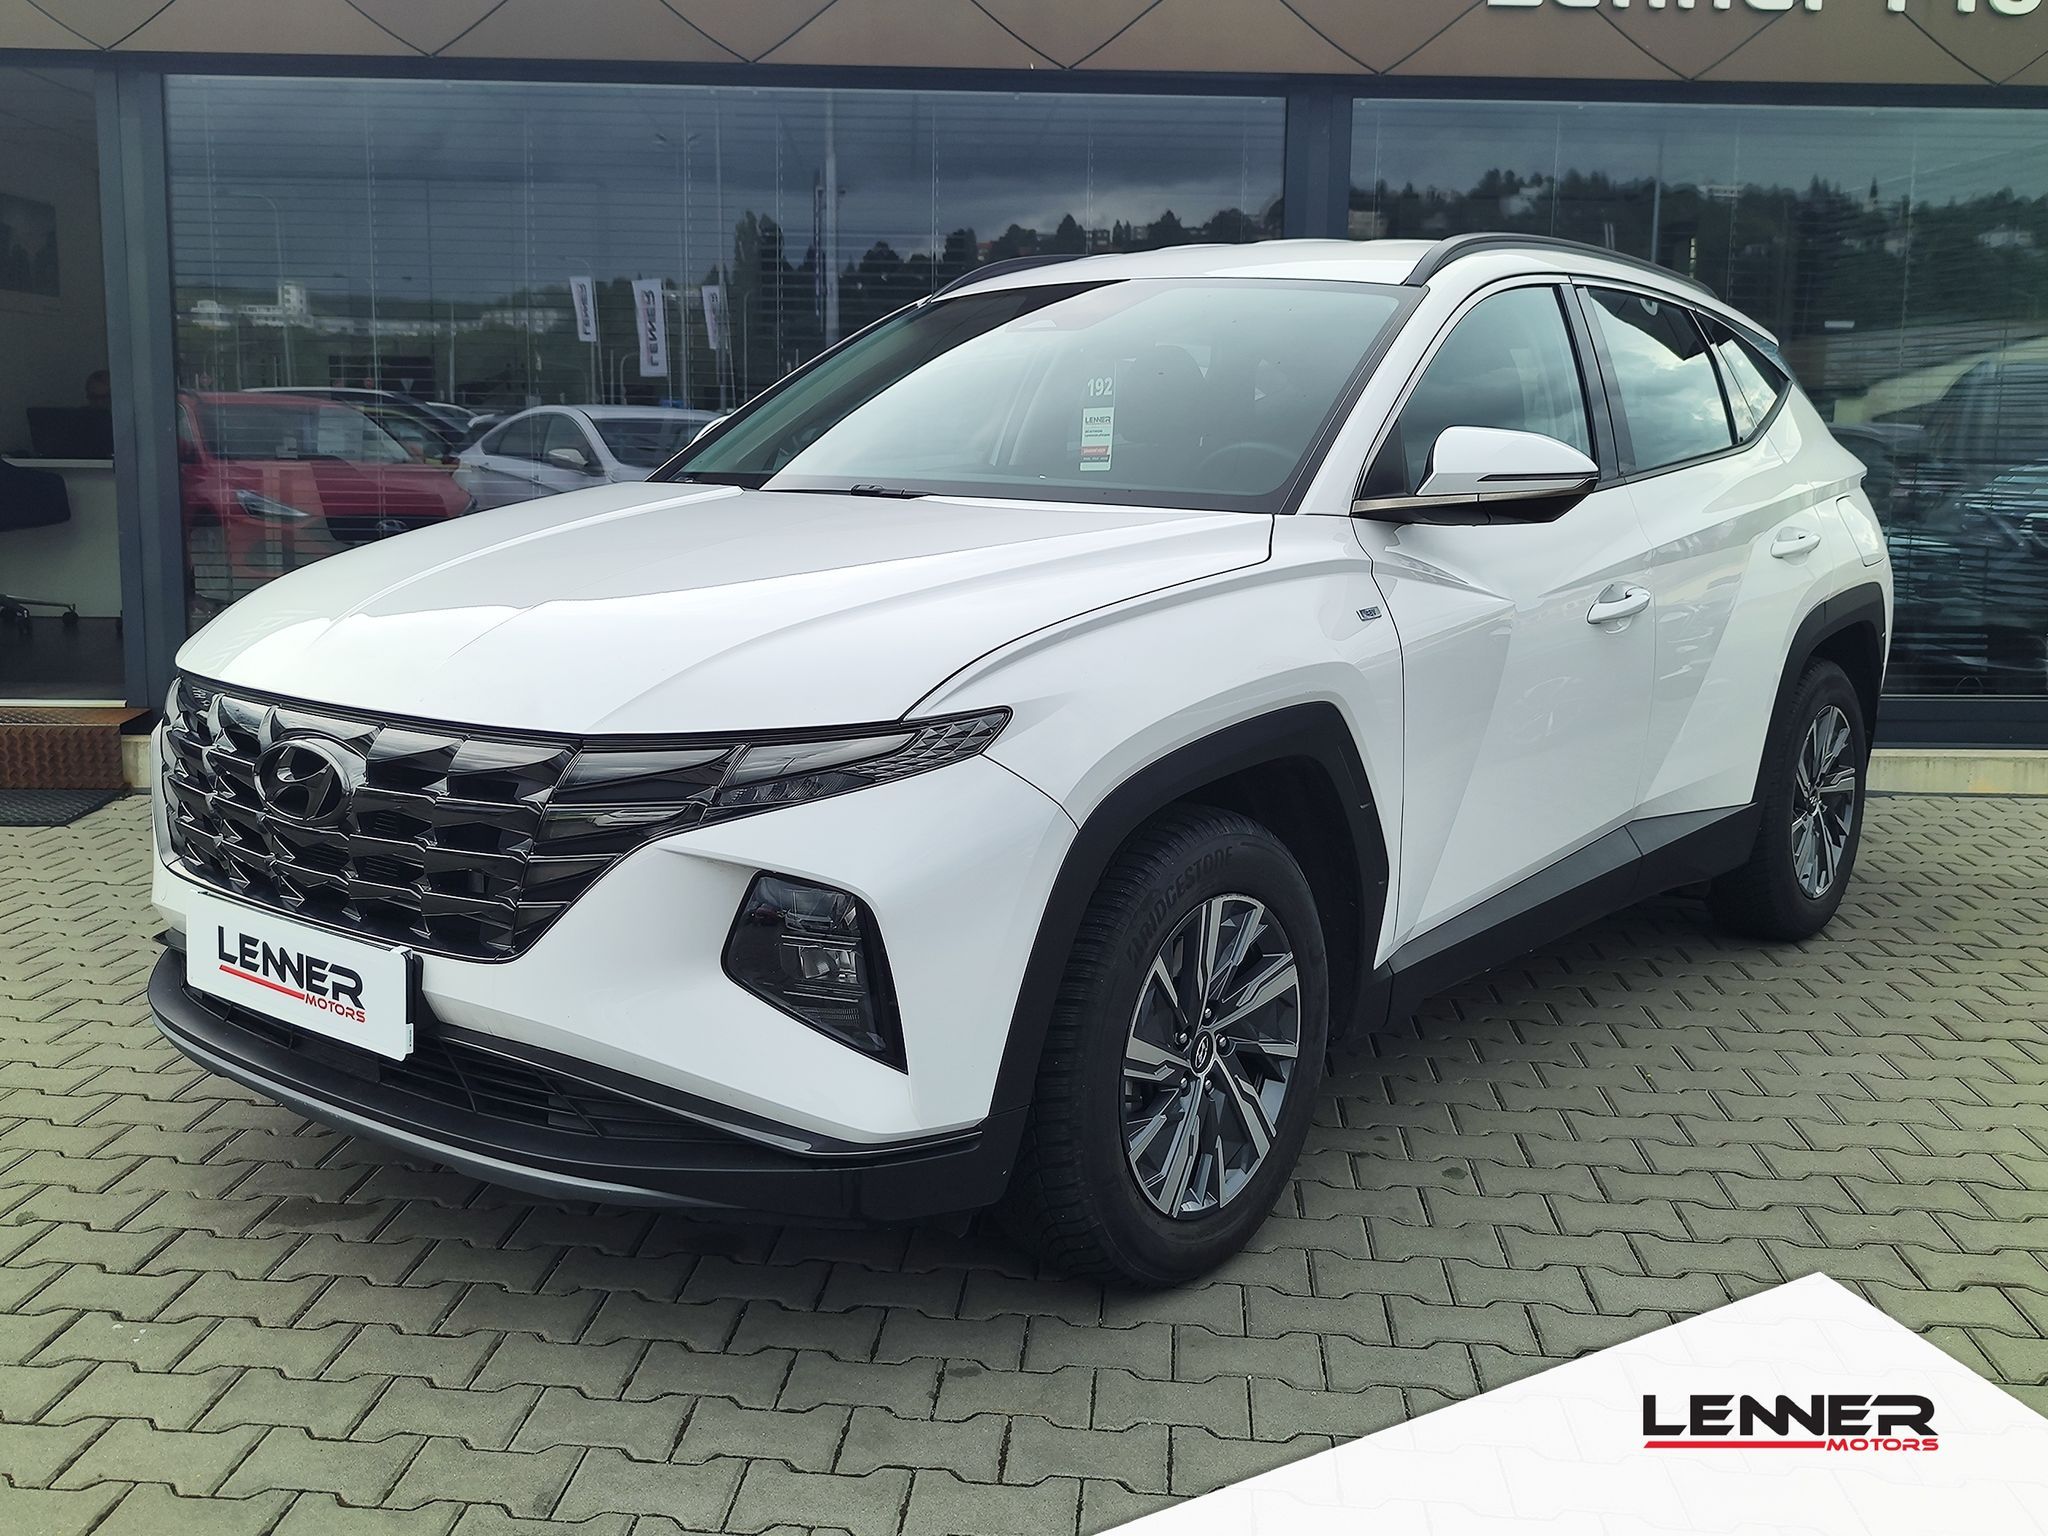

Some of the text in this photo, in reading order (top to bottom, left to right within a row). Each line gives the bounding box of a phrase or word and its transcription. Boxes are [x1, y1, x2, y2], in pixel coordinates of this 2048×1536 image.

[1087, 377, 1113, 397] 192
[1085, 416, 1111, 424] LENNER
[217, 925, 365, 1010] LENNER
[305, 993, 366, 1023] MOTORS
